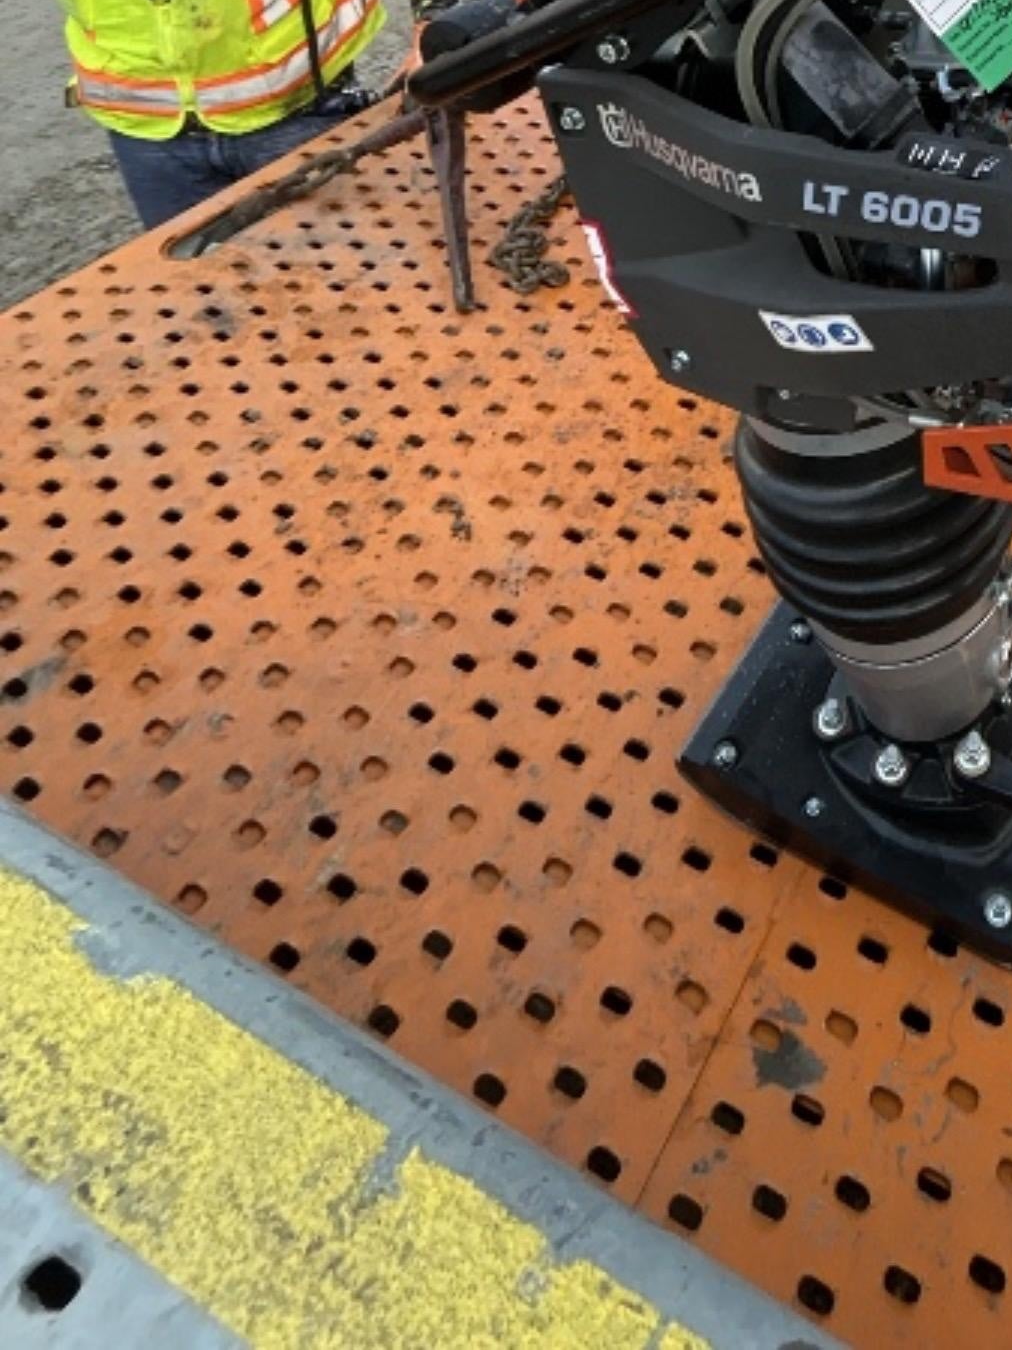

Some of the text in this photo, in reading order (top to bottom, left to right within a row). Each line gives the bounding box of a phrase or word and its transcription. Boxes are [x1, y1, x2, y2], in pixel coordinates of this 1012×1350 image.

[630, 114, 764, 202] Husqvarna
[802, 180, 982, 239] LT 6005
